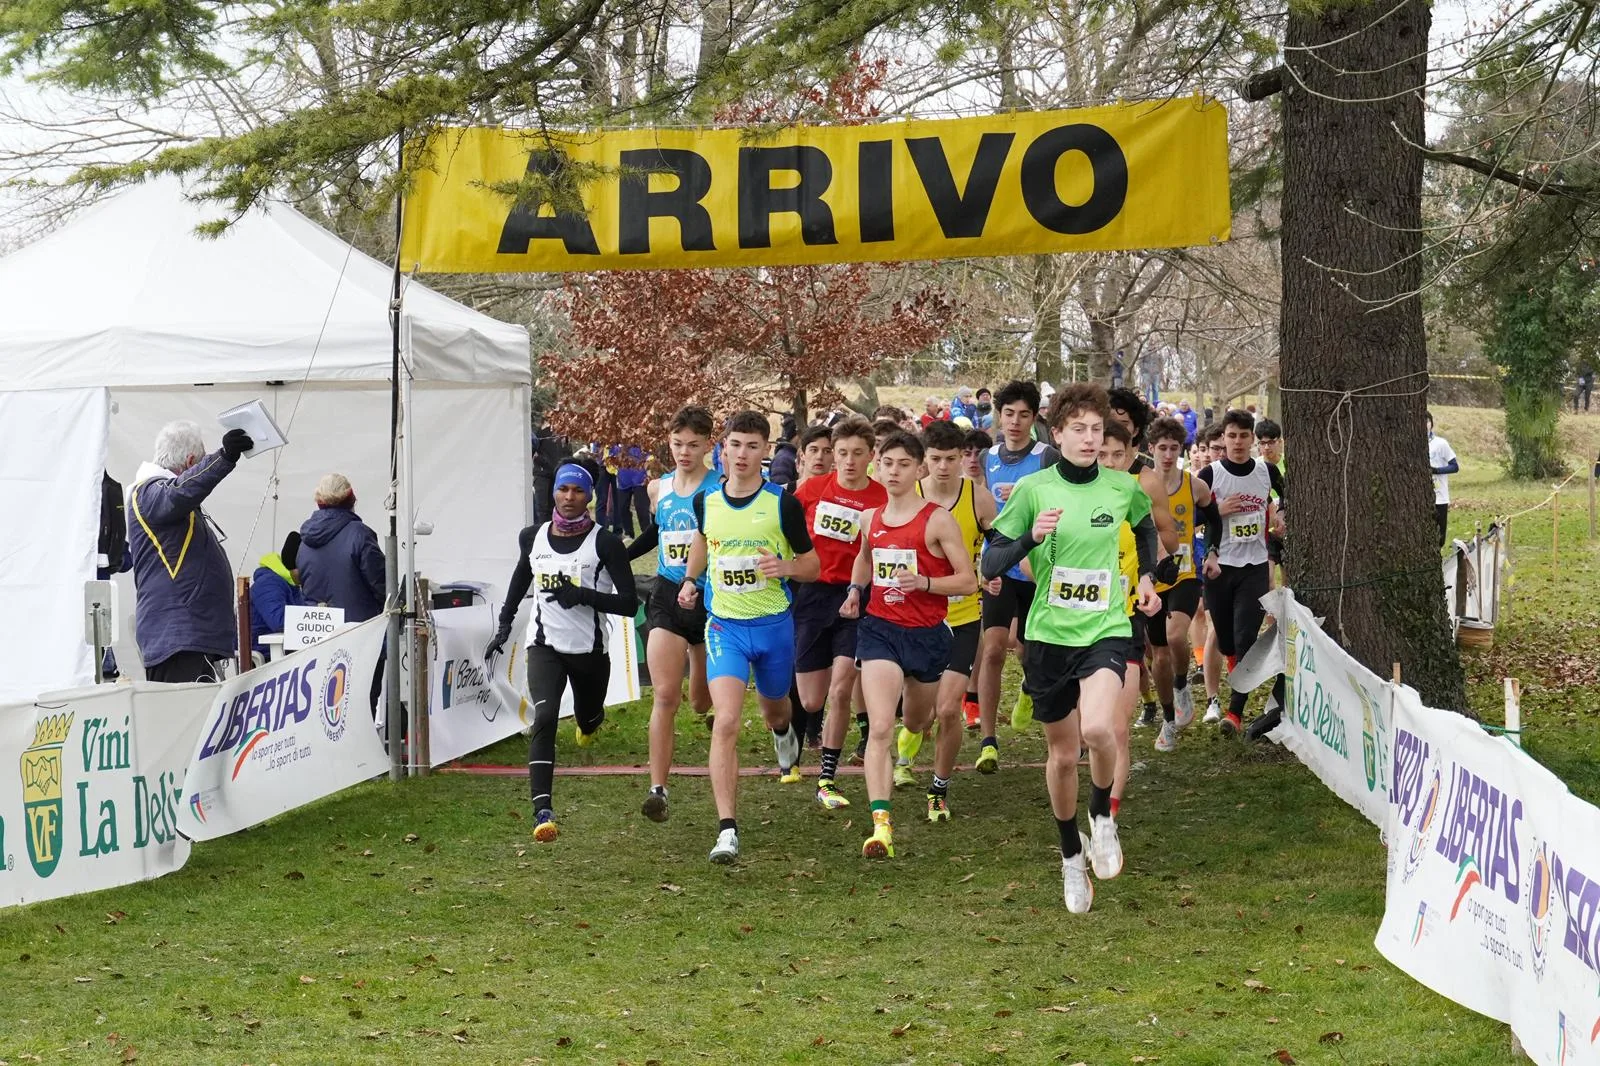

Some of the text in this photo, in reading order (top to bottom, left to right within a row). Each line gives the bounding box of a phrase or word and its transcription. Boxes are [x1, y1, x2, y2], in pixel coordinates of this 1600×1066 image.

[497, 123, 1128, 255] ARRIVO
[820, 514, 852, 535] 552
[1235, 523, 1258, 537] 533
[723, 568, 757, 587] 555
[1059, 582, 1100, 602] 548
[303, 611, 332, 621] AREA
[296, 623, 335, 633] GIUDICI
[199, 658, 318, 761] LIBERTAS
[82, 715, 131, 772] Vini
[258, 744, 274, 761] sport
[276, 753, 292, 770] sport
[77, 781, 120, 859] La
[1436, 761, 1523, 904] LIBERTAS
